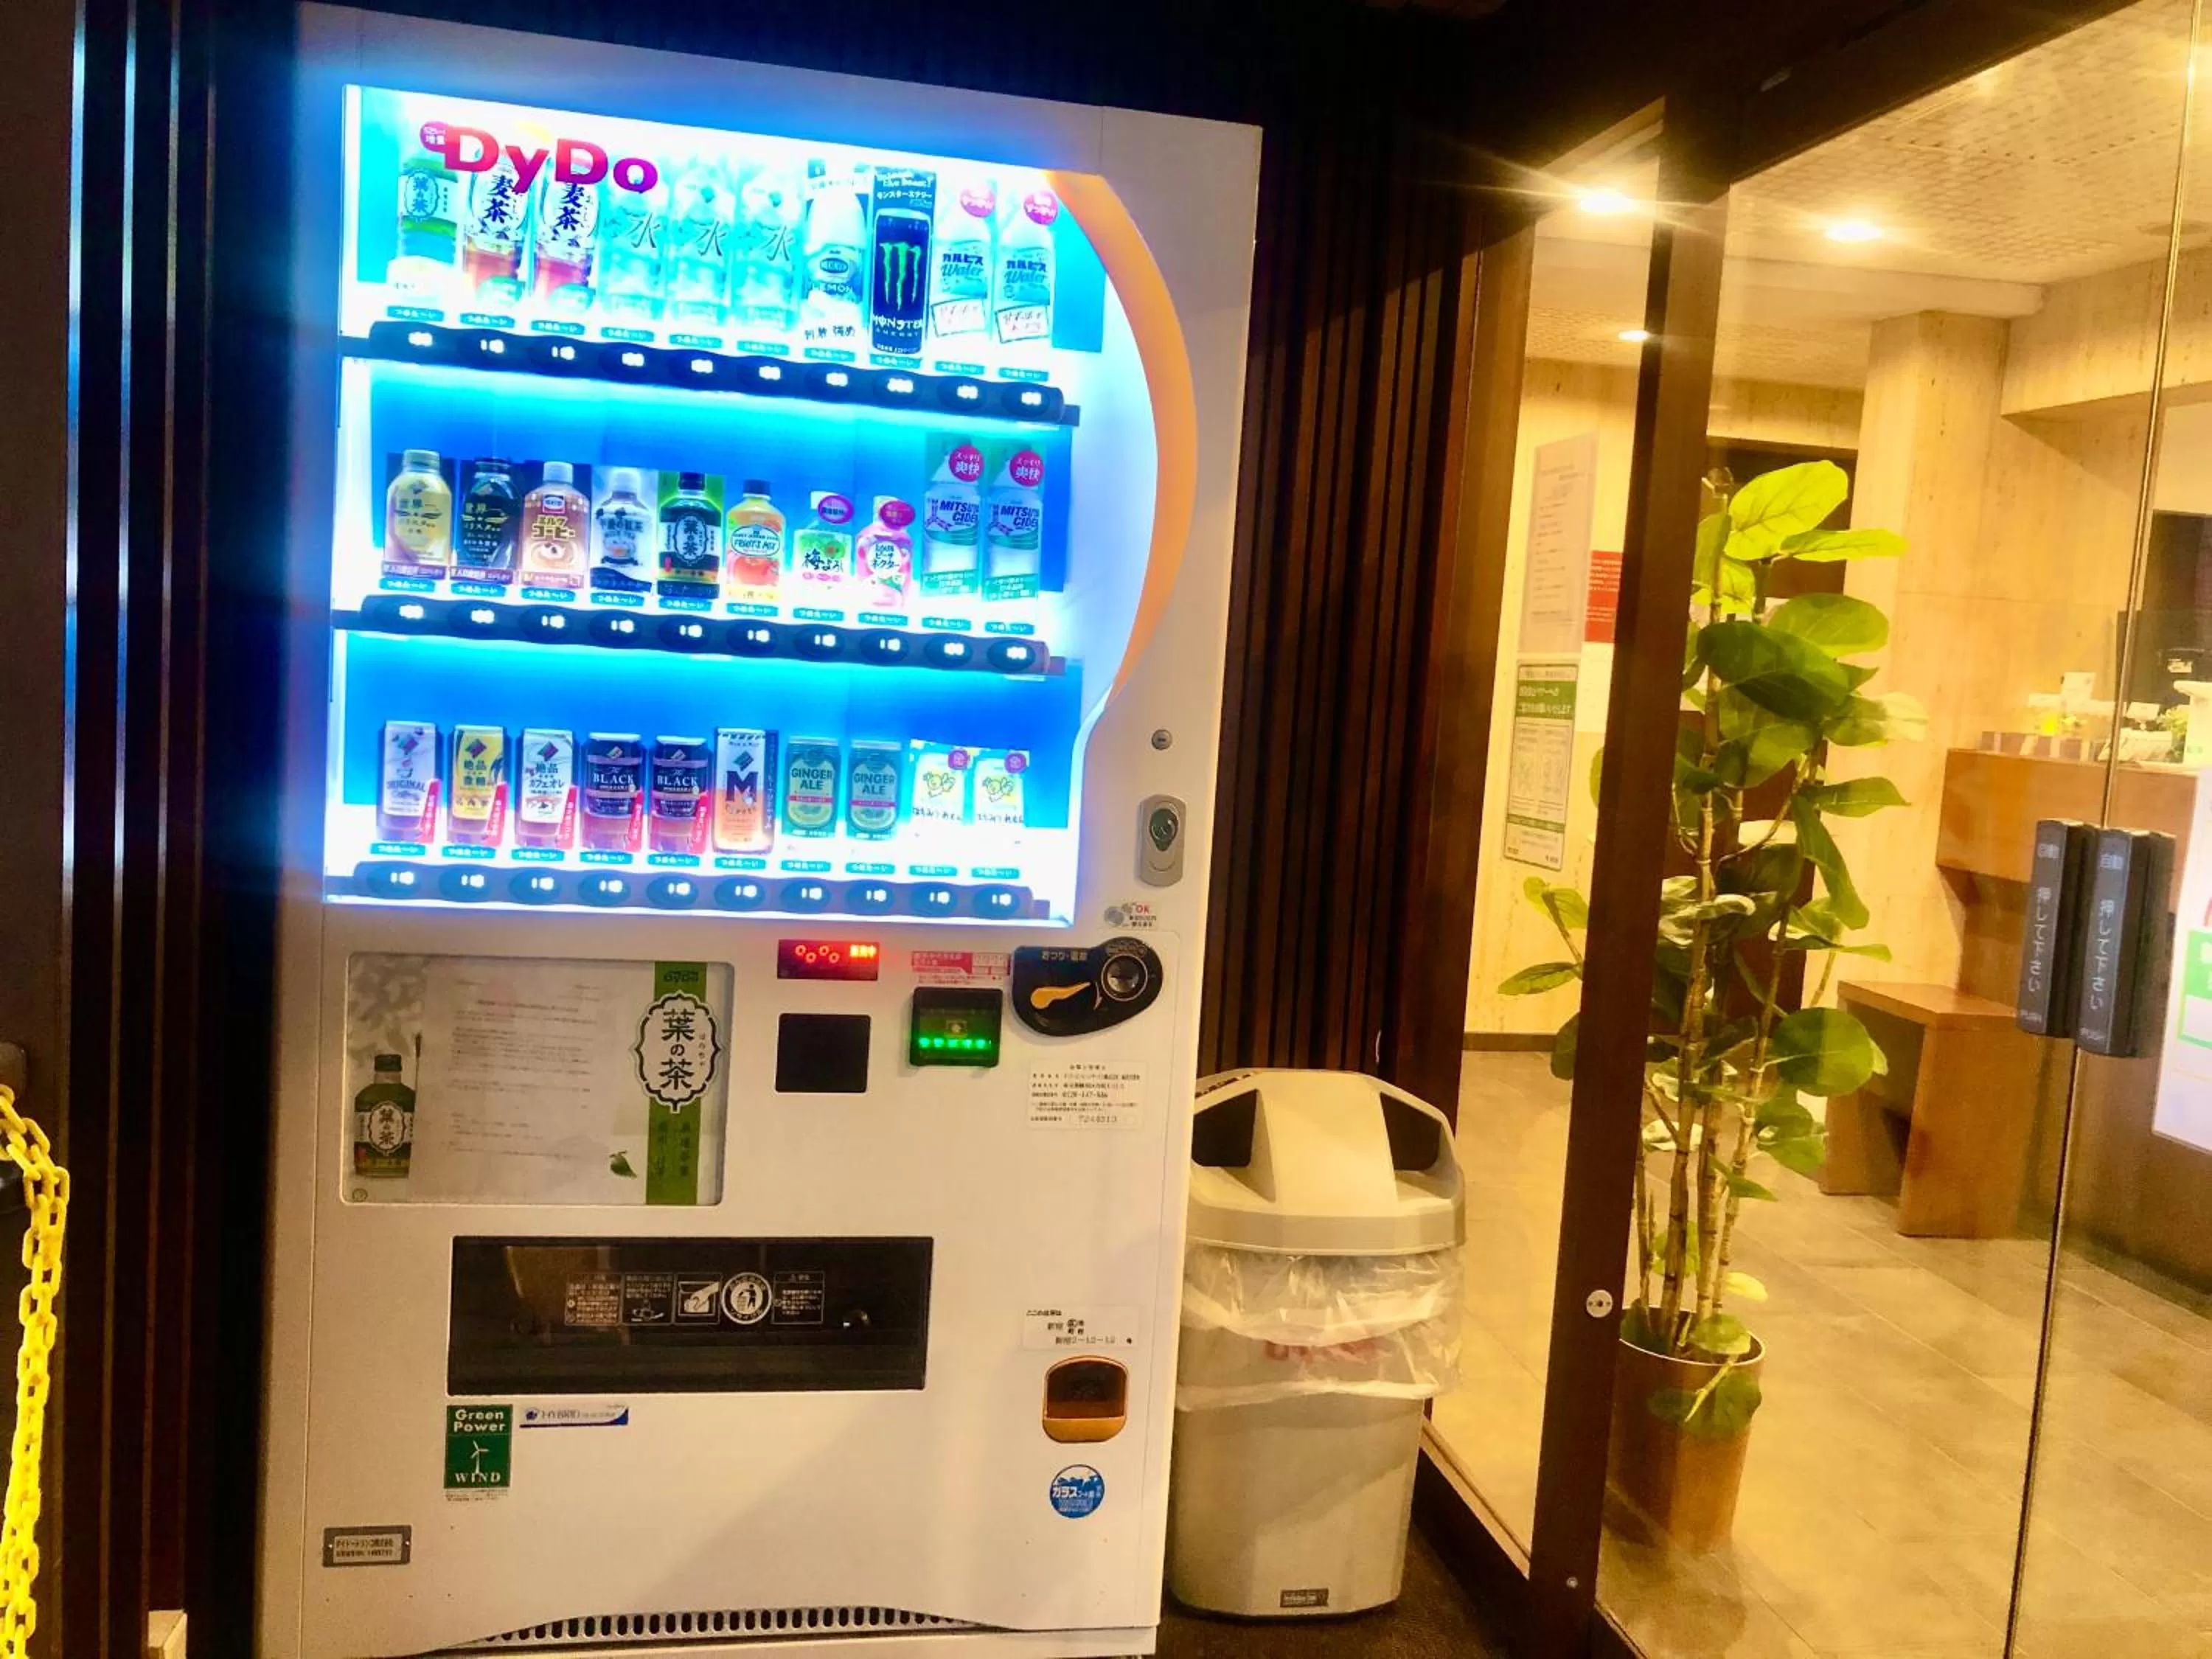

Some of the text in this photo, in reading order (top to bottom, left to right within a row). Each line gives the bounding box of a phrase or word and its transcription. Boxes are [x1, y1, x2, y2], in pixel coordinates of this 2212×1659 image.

[444, 126, 658, 194] DyDo
[483, 174, 514, 224] 麦茶
[624, 212, 661, 248] 水
[695, 220, 730, 257] 水
[765, 220, 795, 262] 水
[955, 460, 981, 476] 爽快
[1015, 465, 1040, 481] 爽快
[593, 772, 635, 785] BLACK
[656, 775, 699, 787] BLACK
[791, 768, 832, 780] GINGER
[853, 772, 896, 784] GINGER
[529, 779, 566, 789] カフェオレ
[726, 771, 759, 803] M
[800, 780, 824, 790] ALE
[861, 785, 886, 795] ALE
[1135, 904, 1150, 914] OK
[2028, 887, 2052, 992] 押して下さい
[2089, 899, 2115, 1011] 押して下さい
[658, 1008, 696, 1091] 葉の茶
[378, 1107, 395, 1145] 葉の茶
[455, 1409, 504, 1421] Green
[453, 1421, 506, 1433] Power
[454, 1471, 501, 1484] WIND
